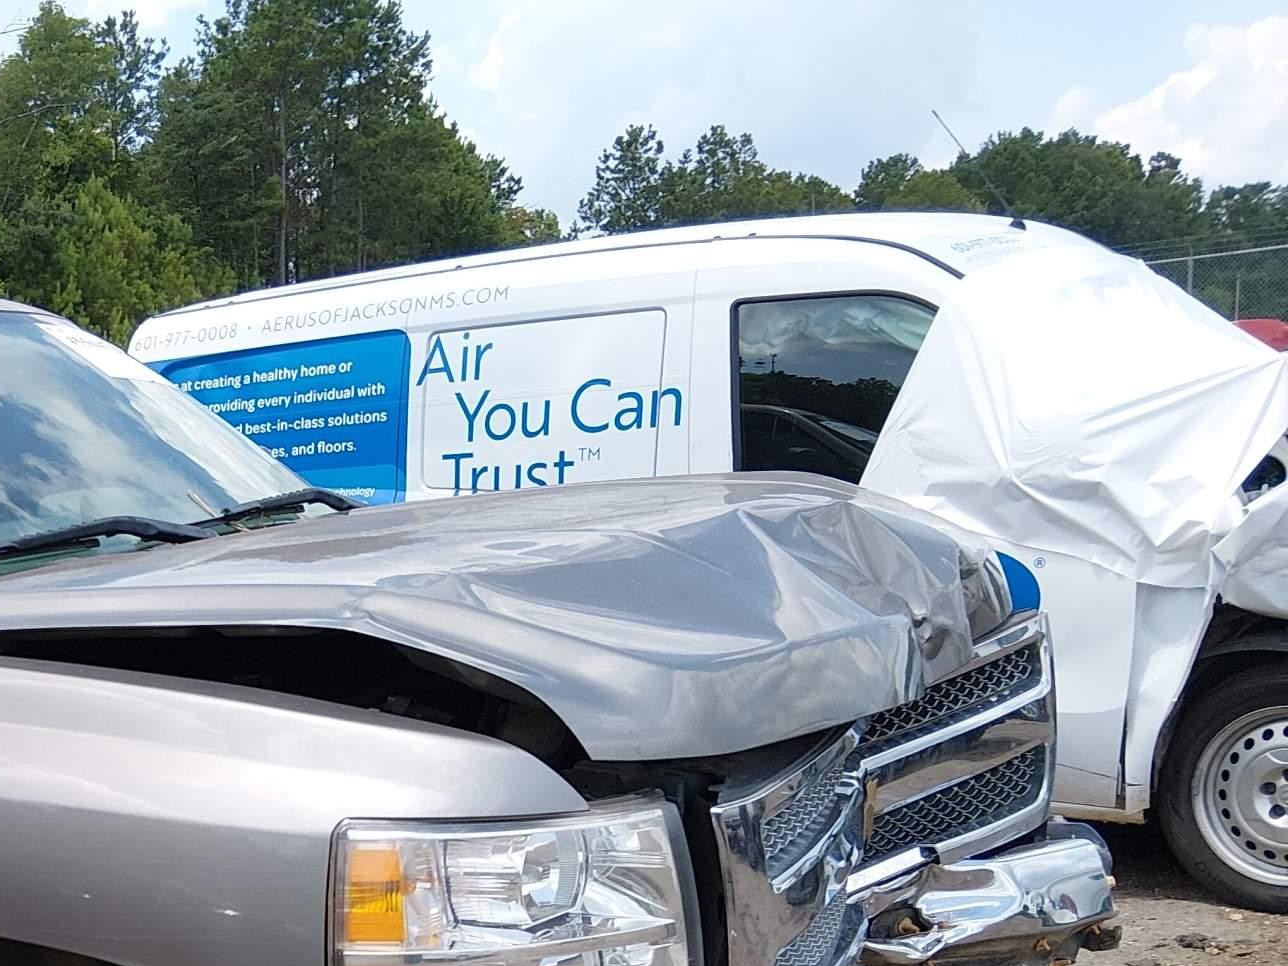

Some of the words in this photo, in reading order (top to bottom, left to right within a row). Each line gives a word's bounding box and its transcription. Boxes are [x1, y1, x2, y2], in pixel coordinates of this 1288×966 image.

[134, 323, 239, 352] 601-977-0008
[261, 286, 511, 334] AERUSOFJACKSONMS.COM
[416, 332, 493, 386] Air
[194, 374, 241, 390] creating
[243, 373, 251, 384] a
[253, 366, 297, 384] healthy
[300, 363, 336, 377] home
[338, 361, 353, 373] or
[257, 395, 291, 409] every
[293, 385, 355, 404] individual
[357, 382, 386, 398] with
[454, 389, 551, 442] You
[570, 378, 683, 433] Can
[245, 417, 325, 435] best-in-class
[327, 410, 388, 428] solutions
[291, 442, 316, 457] and
[317, 440, 357, 454] floors.
